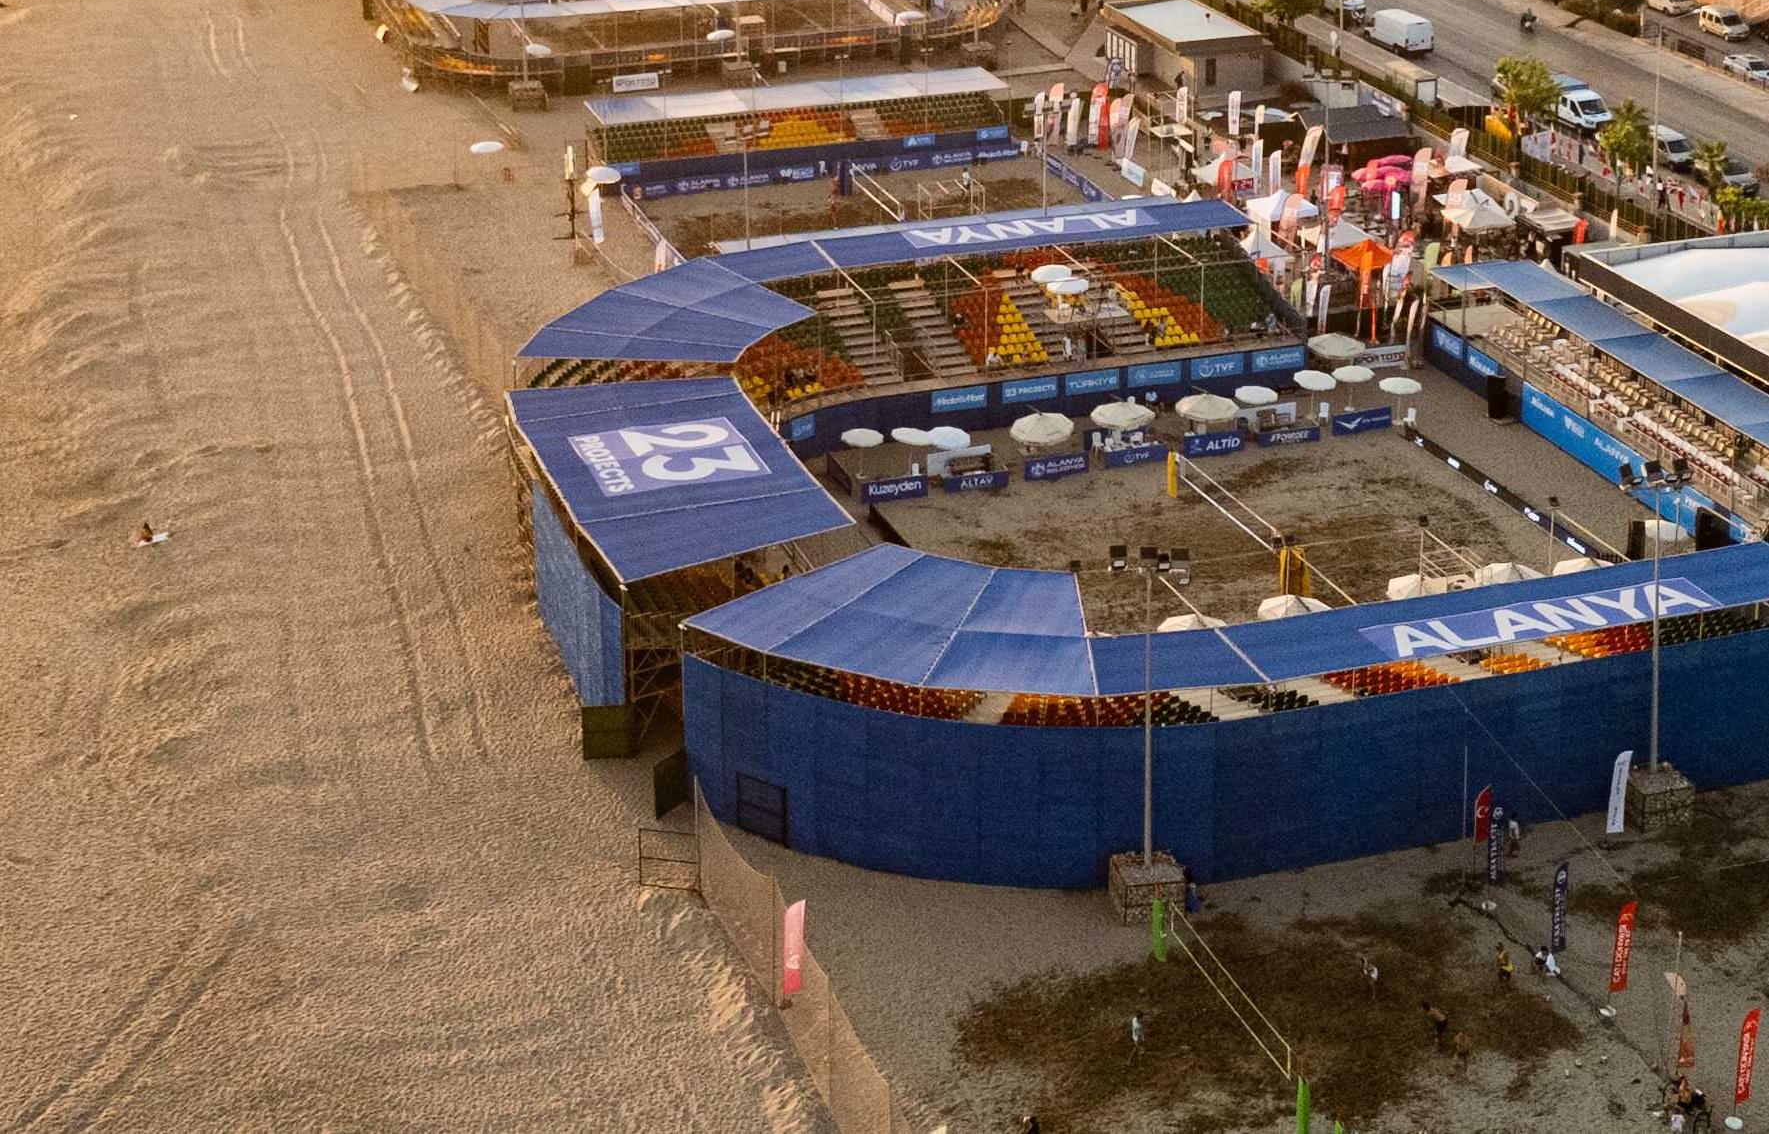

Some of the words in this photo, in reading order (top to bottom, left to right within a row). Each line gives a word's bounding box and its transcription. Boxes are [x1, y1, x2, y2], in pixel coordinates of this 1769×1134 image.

[909, 209, 1138, 244] ALANYA
[1214, 361, 1235, 373] TVF
[574, 435, 635, 493] PROJECTS
[618, 423, 760, 481] 23
[1046, 457, 1085, 468] ALANYA
[868, 480, 922, 496] Kuzeyden
[1393, 582, 1713, 658] ALANYA
